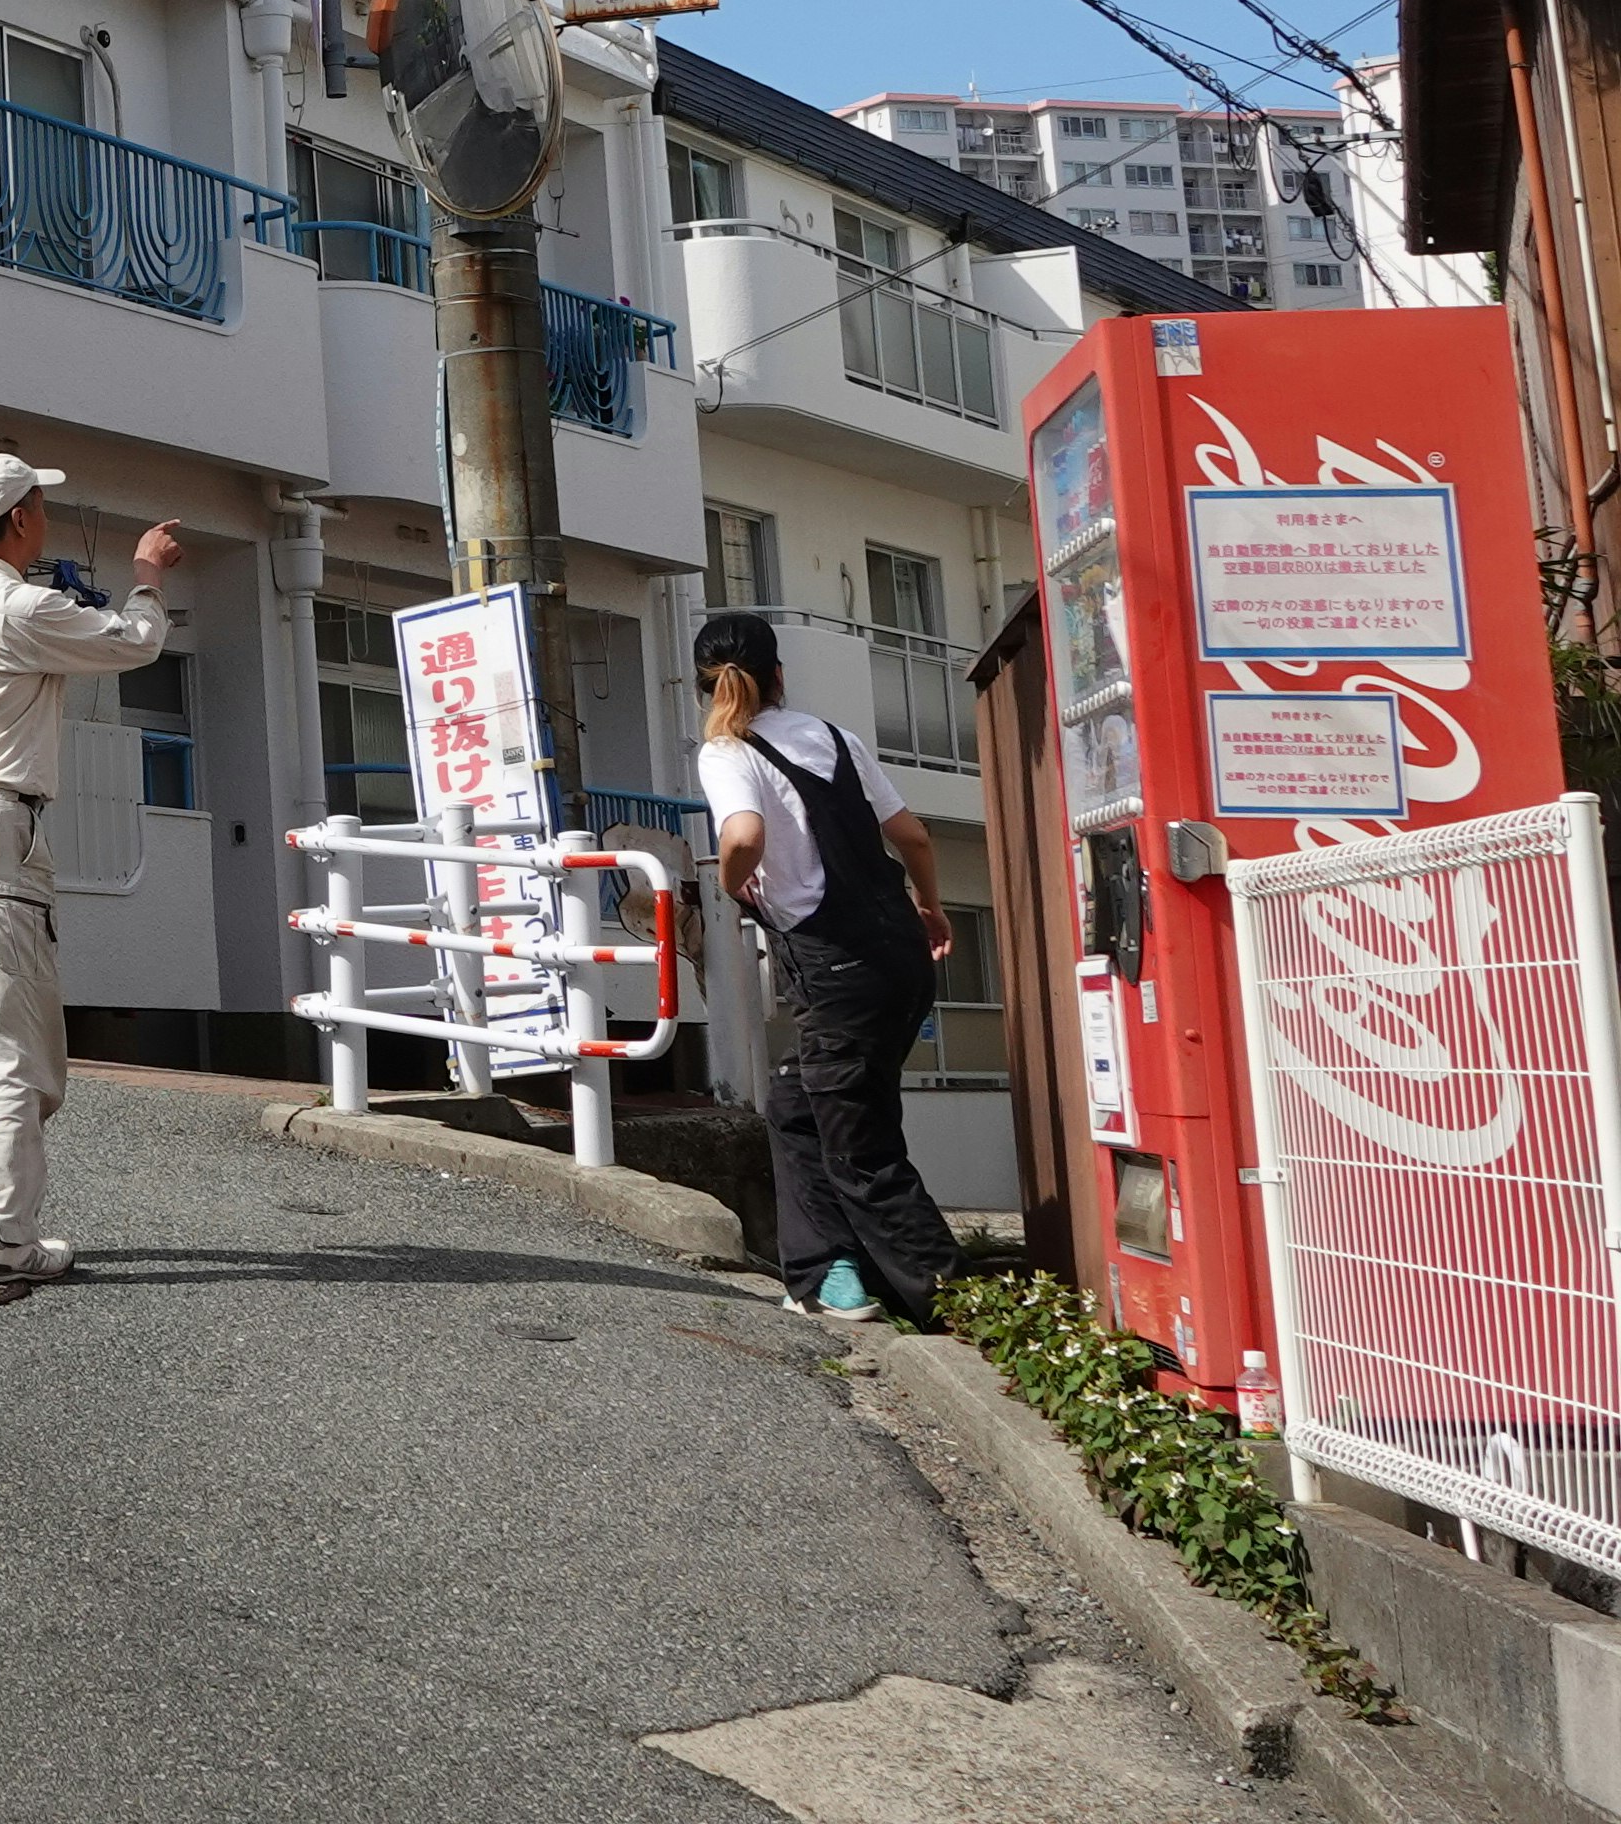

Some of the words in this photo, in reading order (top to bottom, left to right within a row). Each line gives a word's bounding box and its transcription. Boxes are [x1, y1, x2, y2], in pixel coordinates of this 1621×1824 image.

[1276, 513, 1364, 526] 利用者さまへ
[1207, 543, 1441, 556] 当自動販売機へ設置しておりました
[1223, 560, 1427, 574] 空容器回収BOXは撤去しました
[1212, 599, 1445, 612] 近隣の方々の迷惑にもなりますので
[1242, 616, 1418, 629] 一切の投棄ご遠慮ください
[1271, 712, 1333, 721] 利用者さまへ
